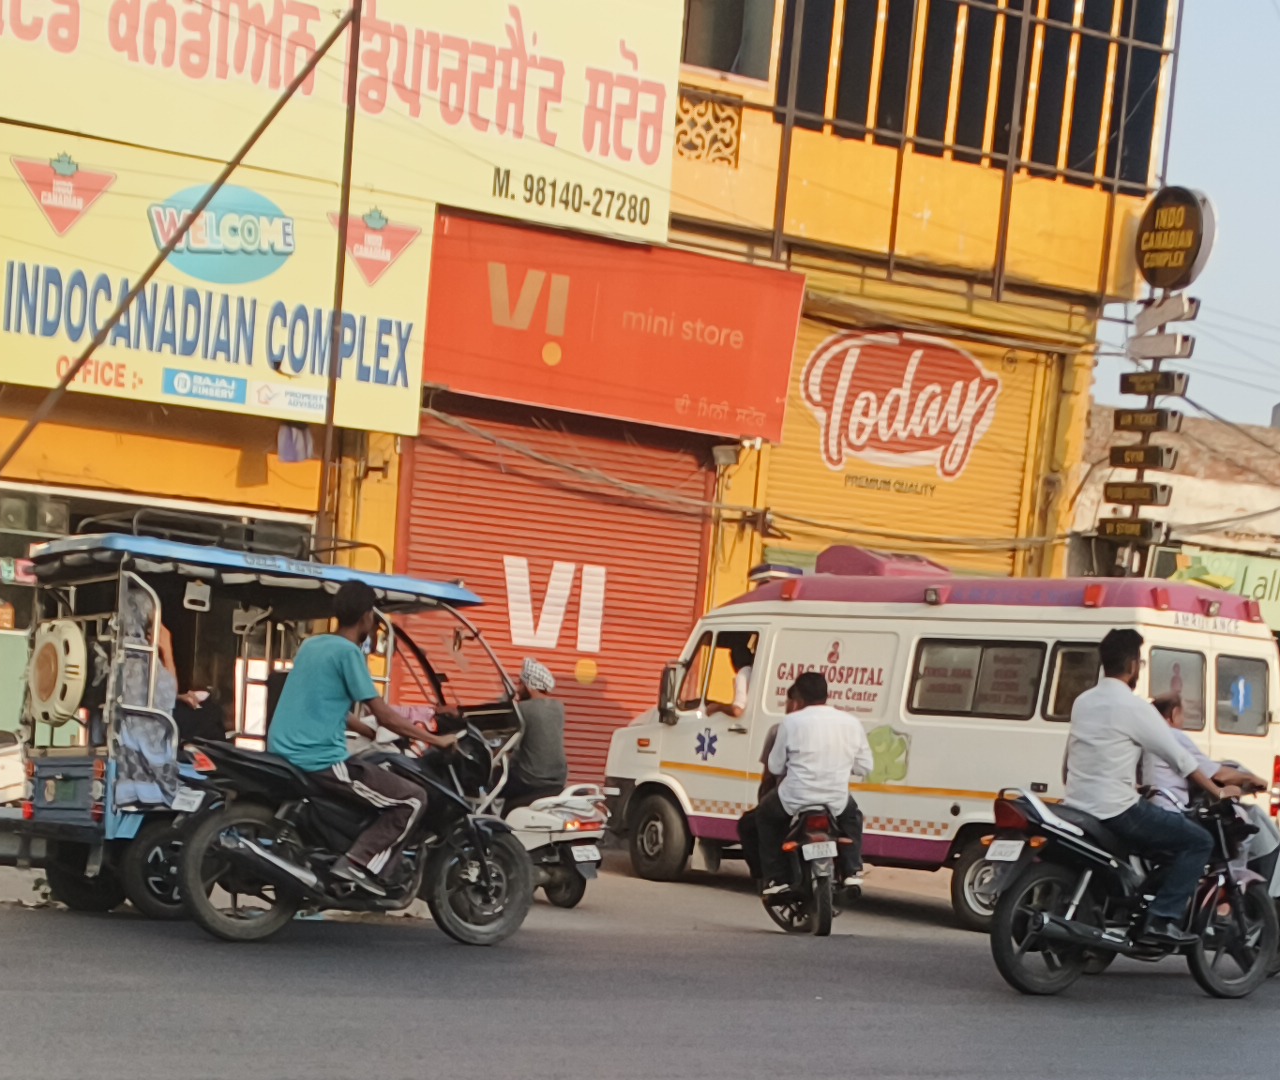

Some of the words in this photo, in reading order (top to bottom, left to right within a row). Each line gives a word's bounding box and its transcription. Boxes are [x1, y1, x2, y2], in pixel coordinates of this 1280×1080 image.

[492, 167, 515, 201] M.
[523, 173, 651, 226] 98140-27280
[150, 205, 294, 254] WELCOME
[1155, 206, 1186, 230] INDO
[1141, 229, 1194, 251] CANADIAN
[1144, 250, 1186, 269] COMPLEX
[3, 259, 257, 367] INDOCANADIAN
[267, 299, 414, 388] COMPLEX
[621, 307, 675, 337] mini
[681, 316, 745, 349] store
[56, 353, 126, 390] OFFICE
[809, 332, 994, 472] Today
[844, 473, 892, 492] PREMIUM
[892, 478, 937, 497] QUALITY
[819, 664, 884, 687] HOSPITAL
[845, 687, 878, 702] Center
